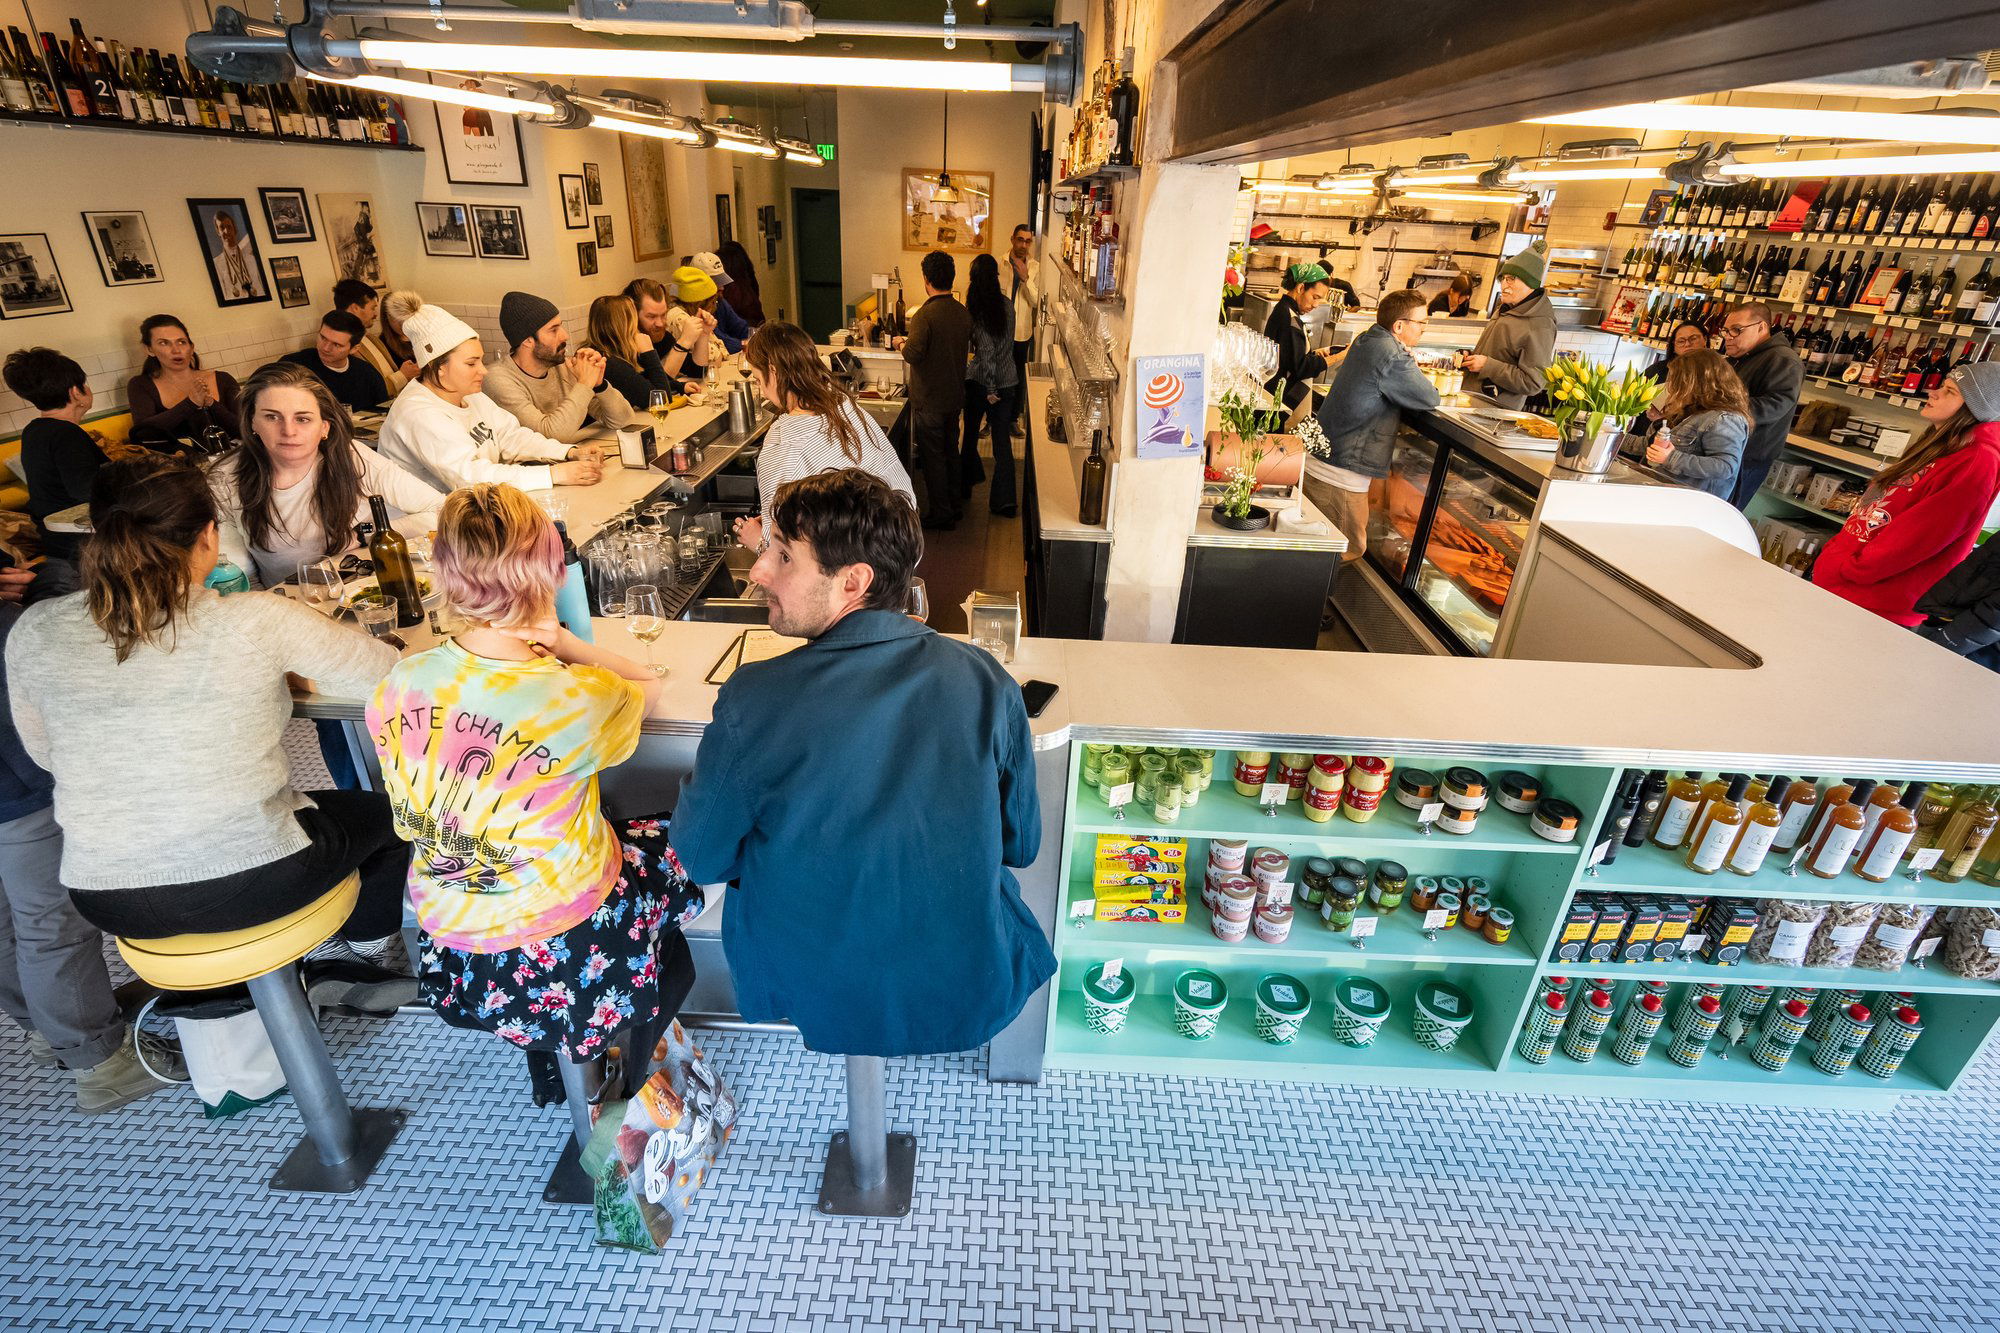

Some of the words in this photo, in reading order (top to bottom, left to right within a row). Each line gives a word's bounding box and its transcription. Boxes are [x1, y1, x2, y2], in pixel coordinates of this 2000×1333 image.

[817, 144, 834, 160] EXIT
[1144, 356, 1201, 369] ORANGINA
[379, 706, 443, 746] STATE
[455, 711, 560, 775] CHAMPS
